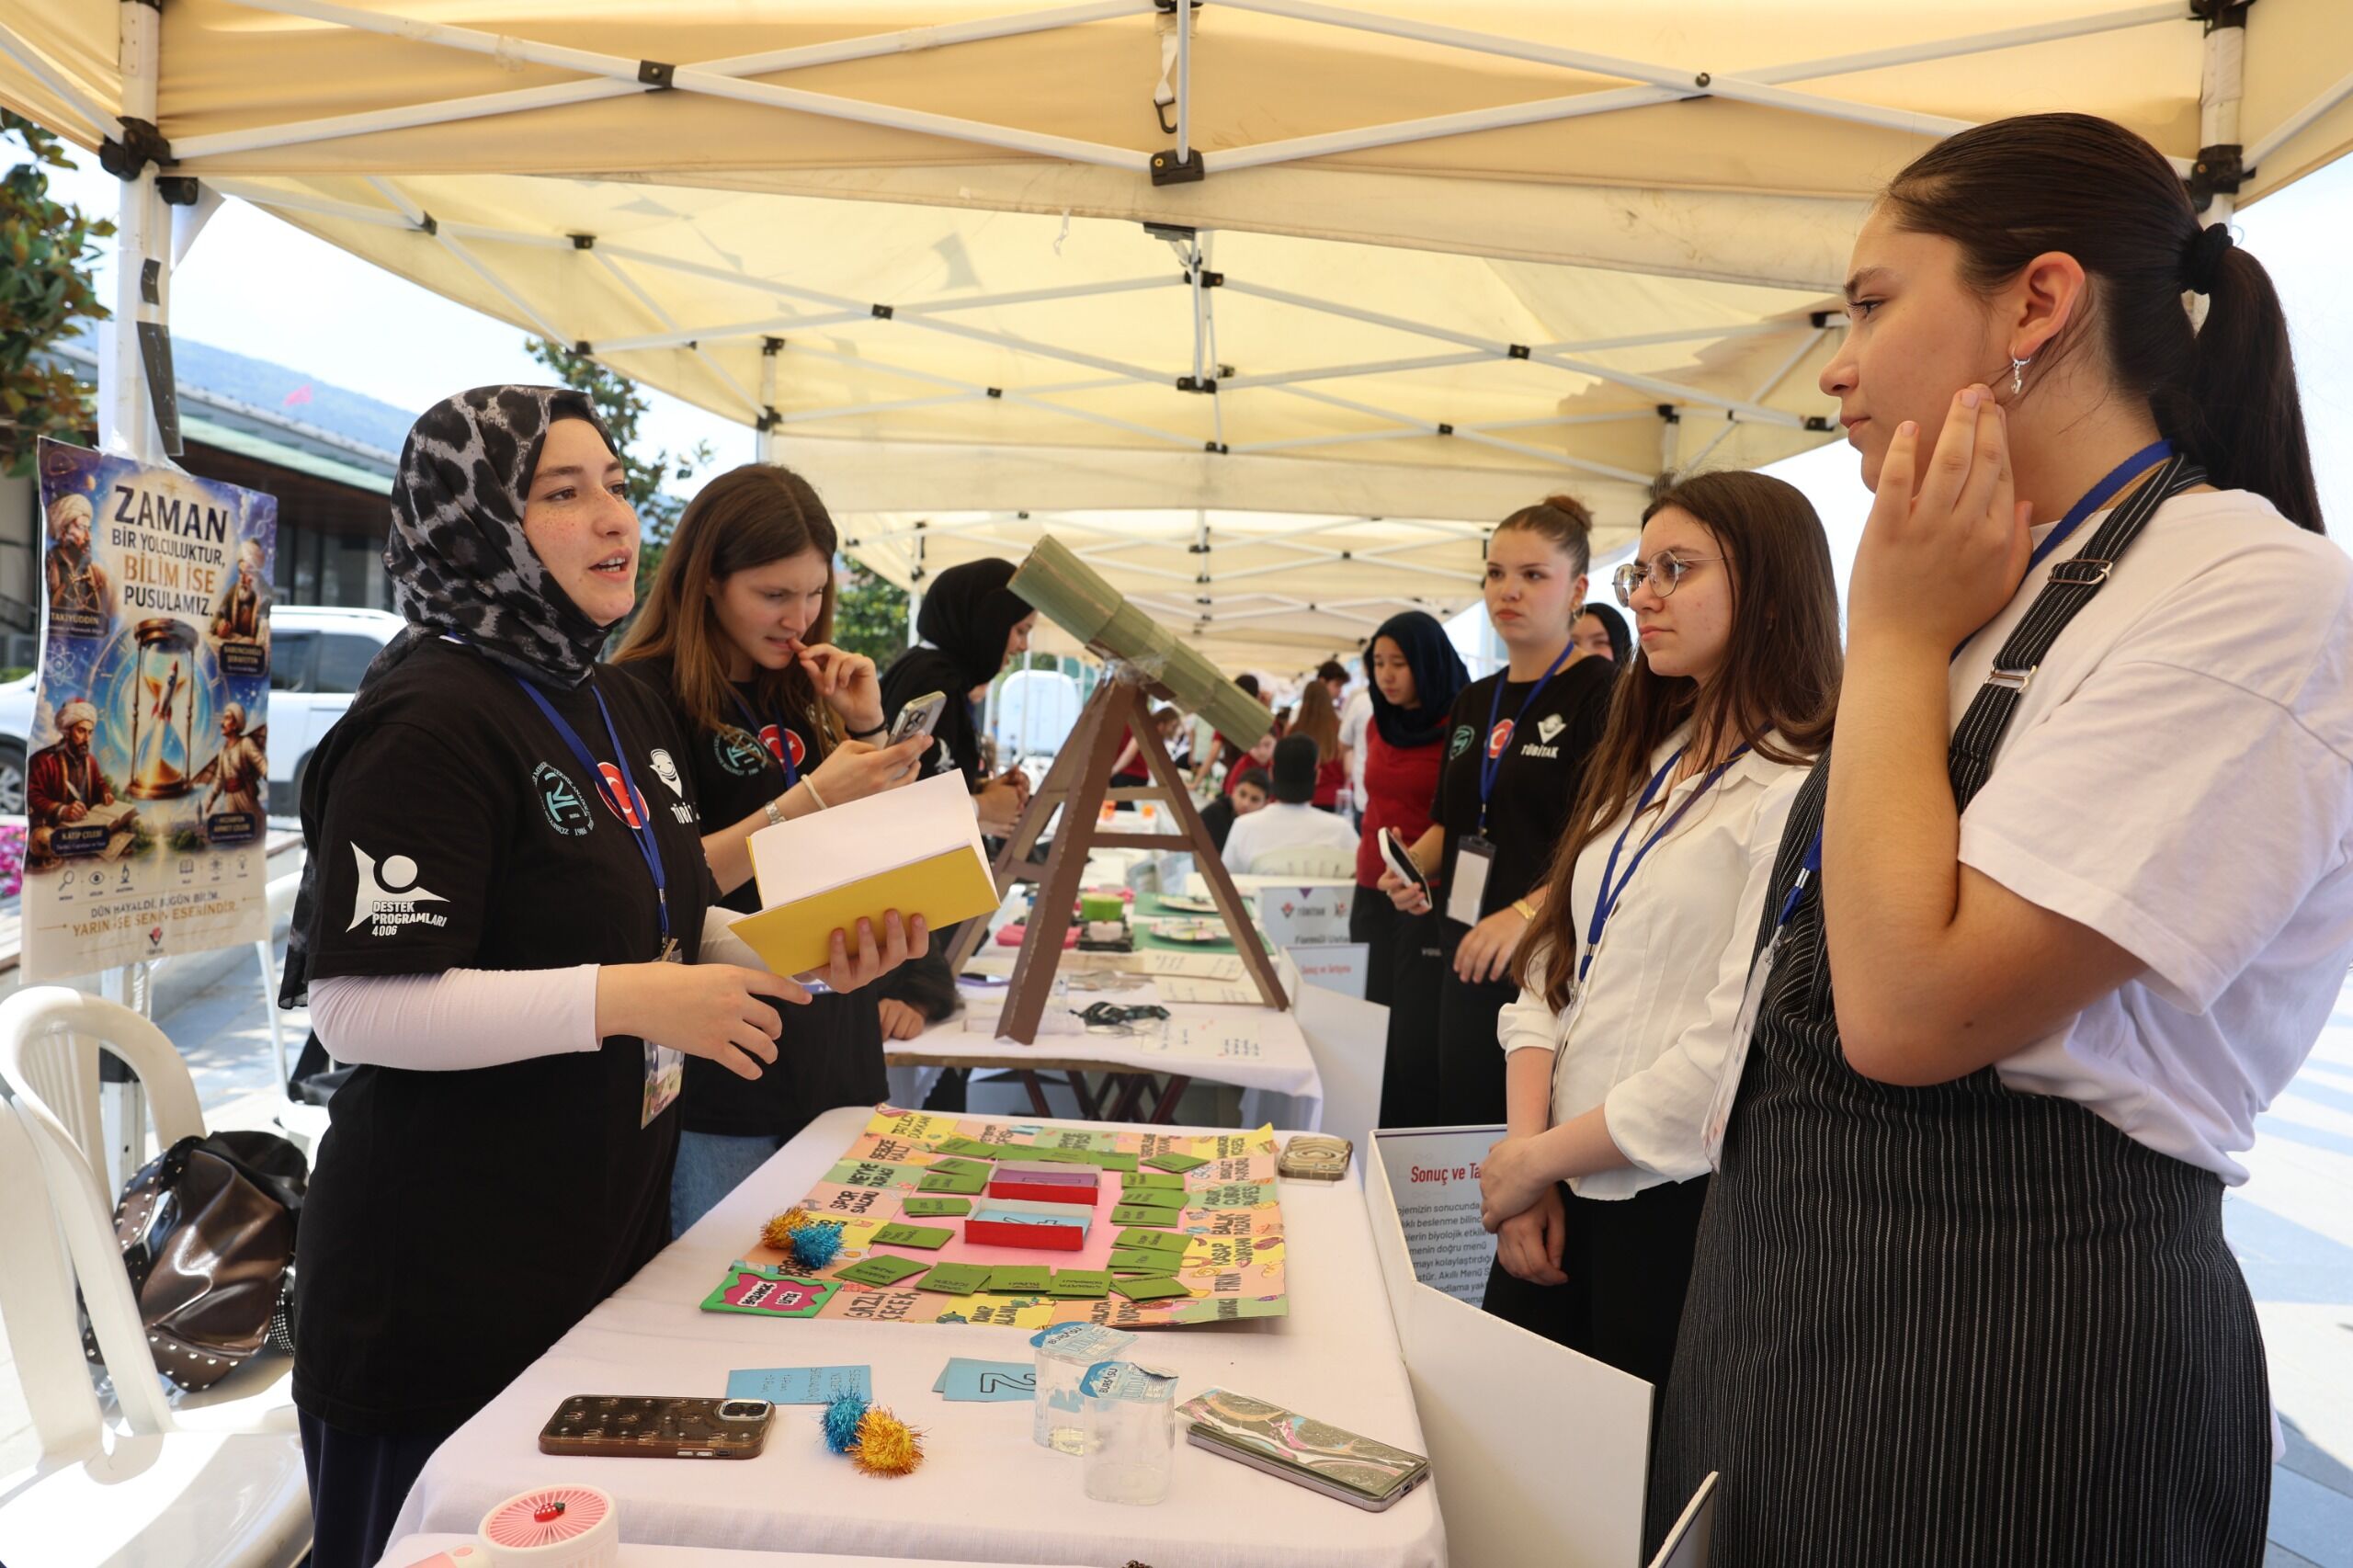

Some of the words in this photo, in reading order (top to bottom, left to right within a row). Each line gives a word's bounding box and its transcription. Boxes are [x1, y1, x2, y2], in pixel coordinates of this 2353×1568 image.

[114, 485, 228, 544] ZAMAN
[112, 526, 136, 549] BİR
[141, 533, 225, 568] YOLCULUKTUR,
[124, 553, 178, 588] BİLİM
[187, 562, 215, 594] İSE
[124, 585, 213, 617] PUSULAMIZ.
[1520, 743, 1560, 759] TÜBİTAK
[372, 901, 415, 913] DESTEK
[371, 913, 448, 927] PROGRAMLARI
[371, 925, 398, 937] 4006
[847, 1163, 880, 1186] MEYVE
[1411, 1165, 1448, 1186] Sonuç
[1452, 1168, 1465, 1179] ve
[829, 1191, 860, 1210] SPOR
[850, 1191, 880, 1213] SALONU
[1416, 1216, 1459, 1228] beslenme
[1428, 1230, 1462, 1243] biyolojik
[1437, 1244, 1461, 1256] doğru
[1463, 1241, 1487, 1251] menü
[1460, 1268, 1483, 1279] Menü
[843, 1291, 889, 1319] GAZLI
